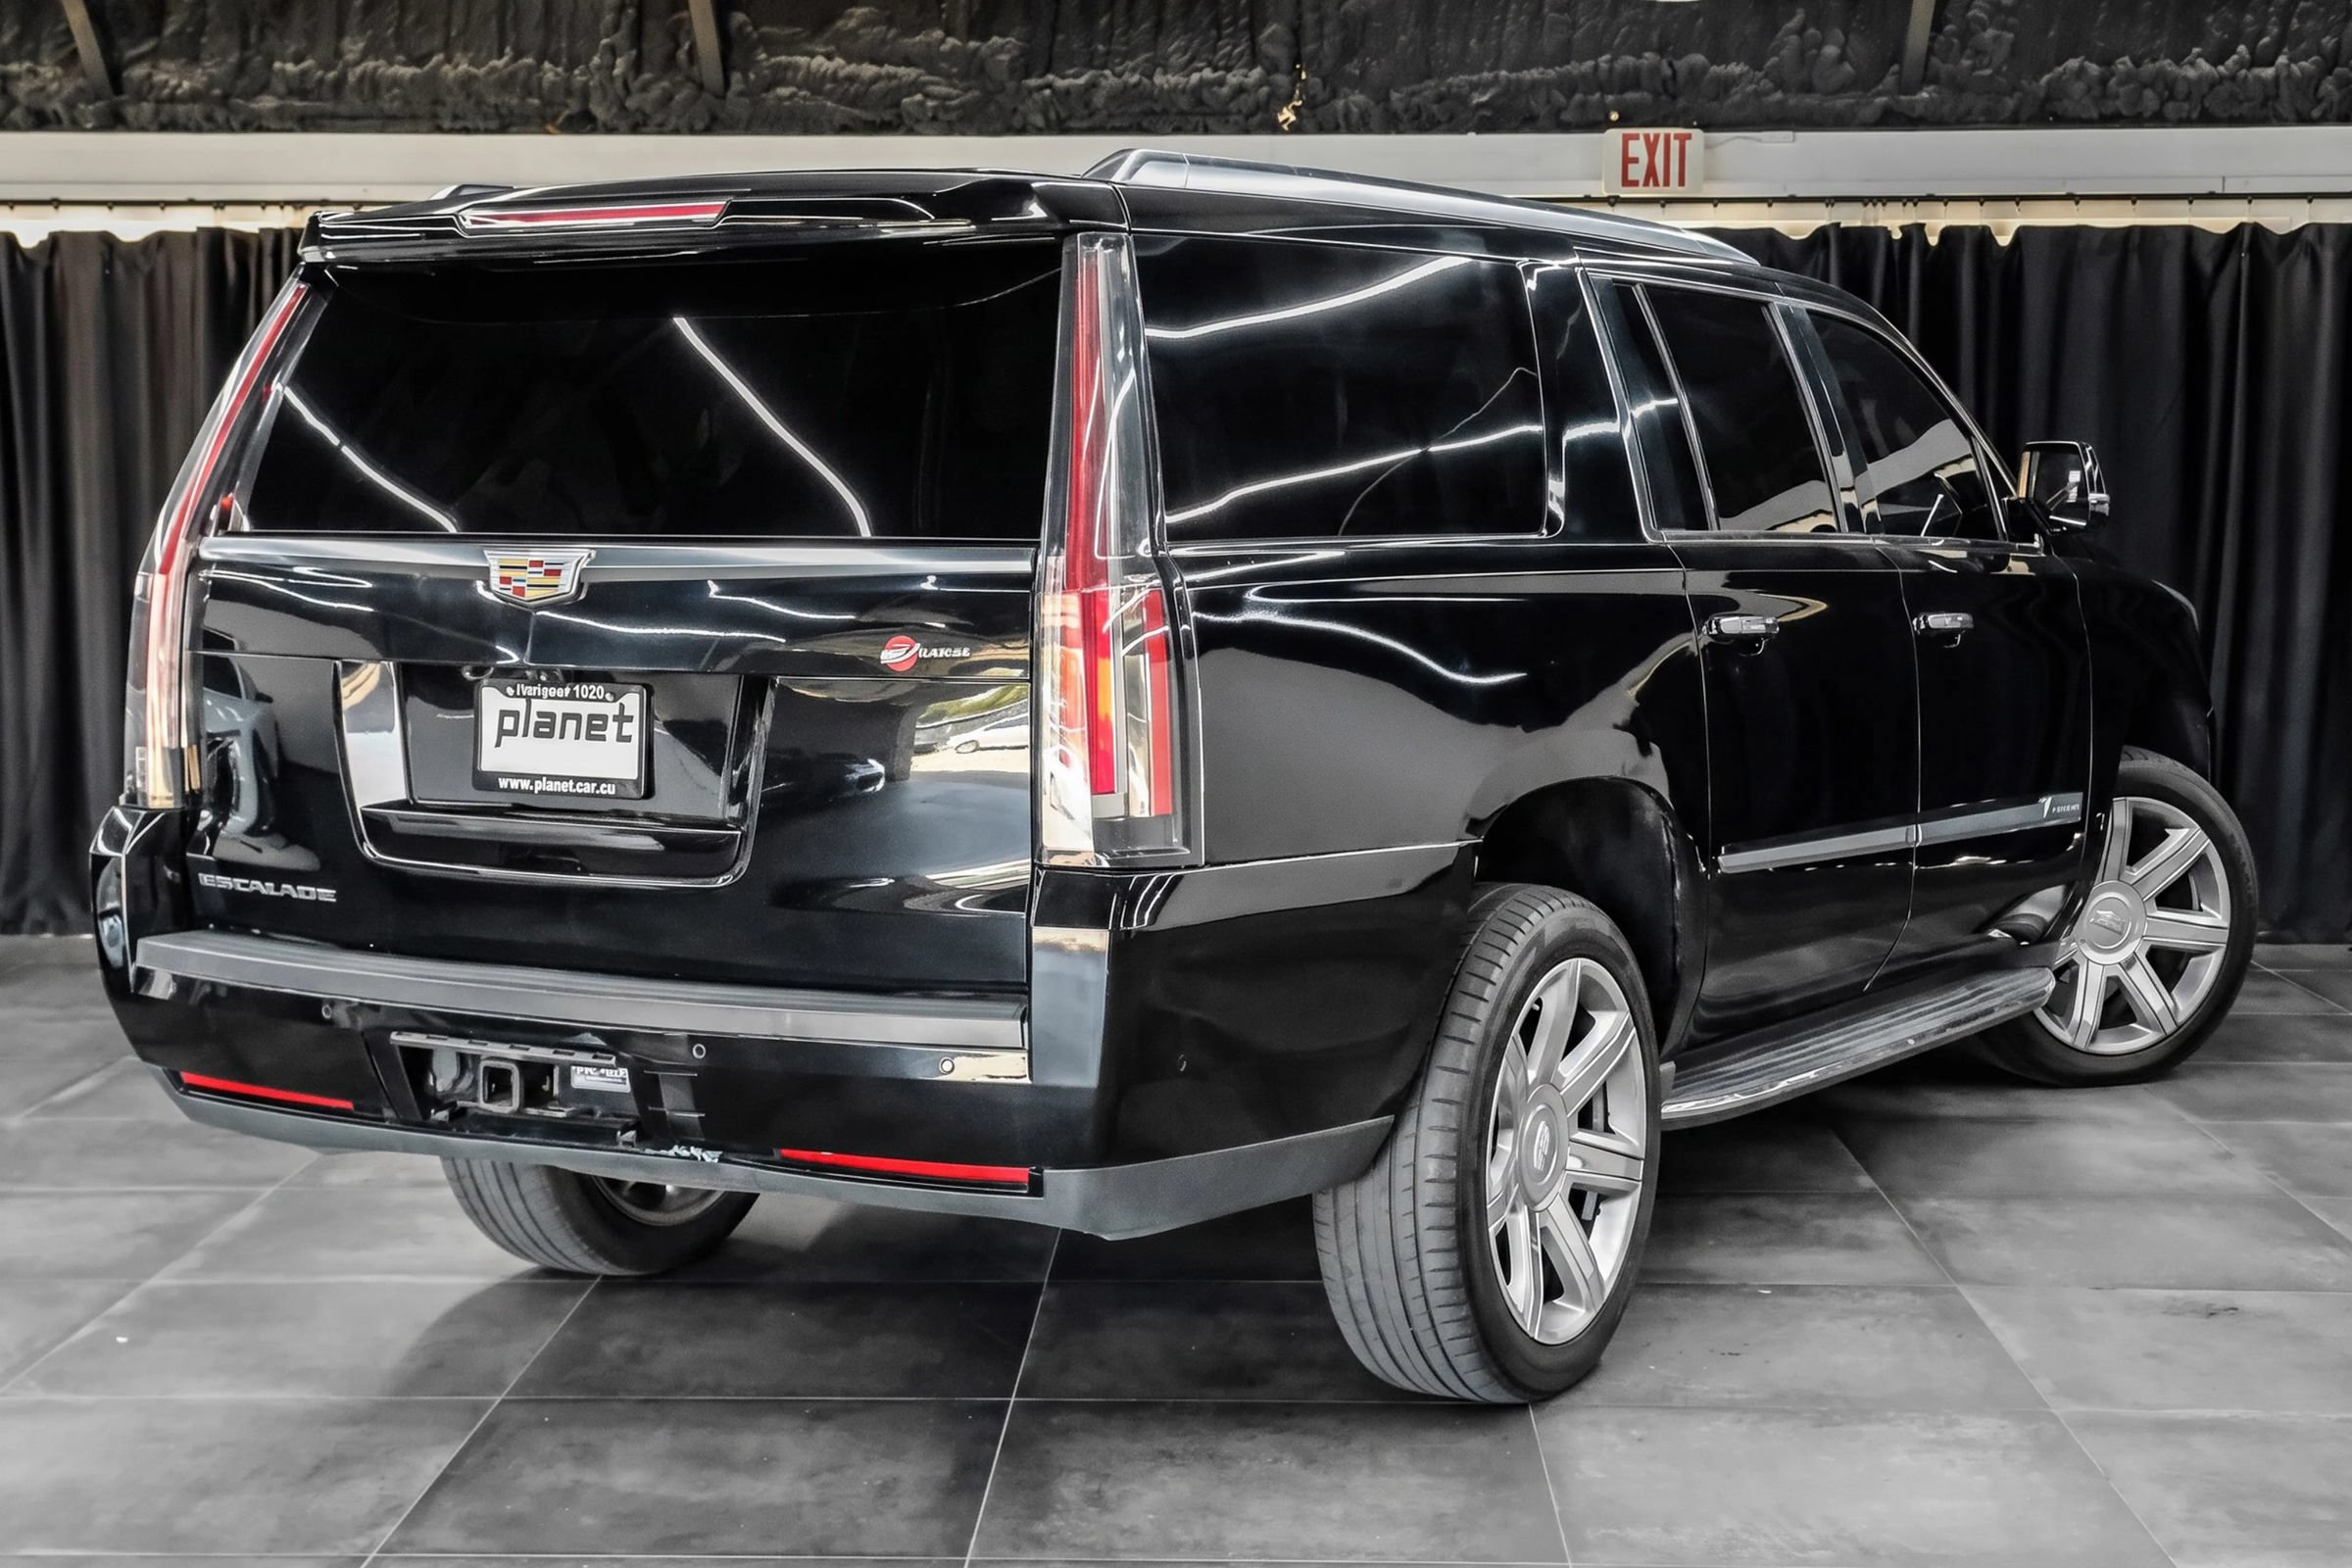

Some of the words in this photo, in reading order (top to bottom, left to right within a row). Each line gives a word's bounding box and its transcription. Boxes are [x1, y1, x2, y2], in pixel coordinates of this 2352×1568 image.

[1621, 132, 1692, 188] EXIT
[573, 684, 605, 700] 1020
[494, 698, 634, 749] planet
[198, 872, 337, 903] ESCALADE
